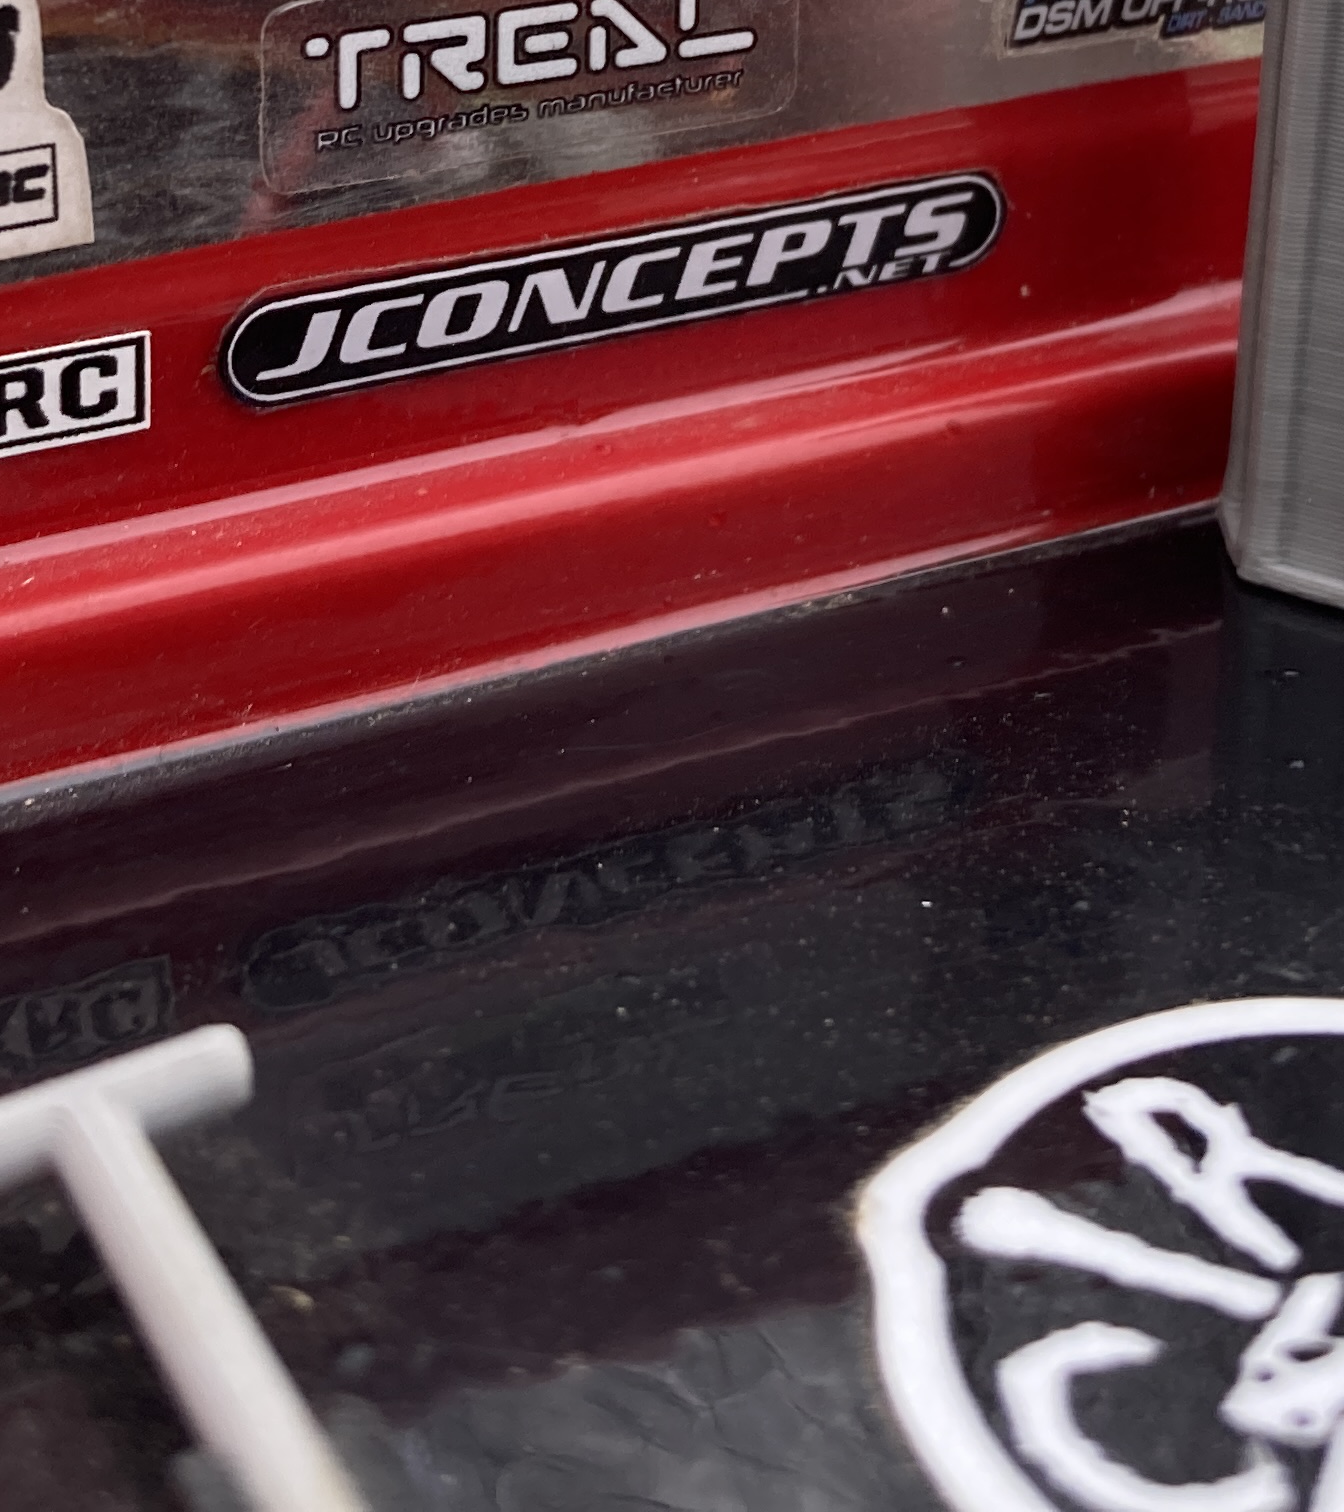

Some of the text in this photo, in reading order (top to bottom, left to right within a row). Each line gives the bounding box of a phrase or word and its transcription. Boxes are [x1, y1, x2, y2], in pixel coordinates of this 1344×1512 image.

[315, 68, 745, 153] RC upgrades manufacturer
[256, 191, 975, 381] JCONCEPTS
